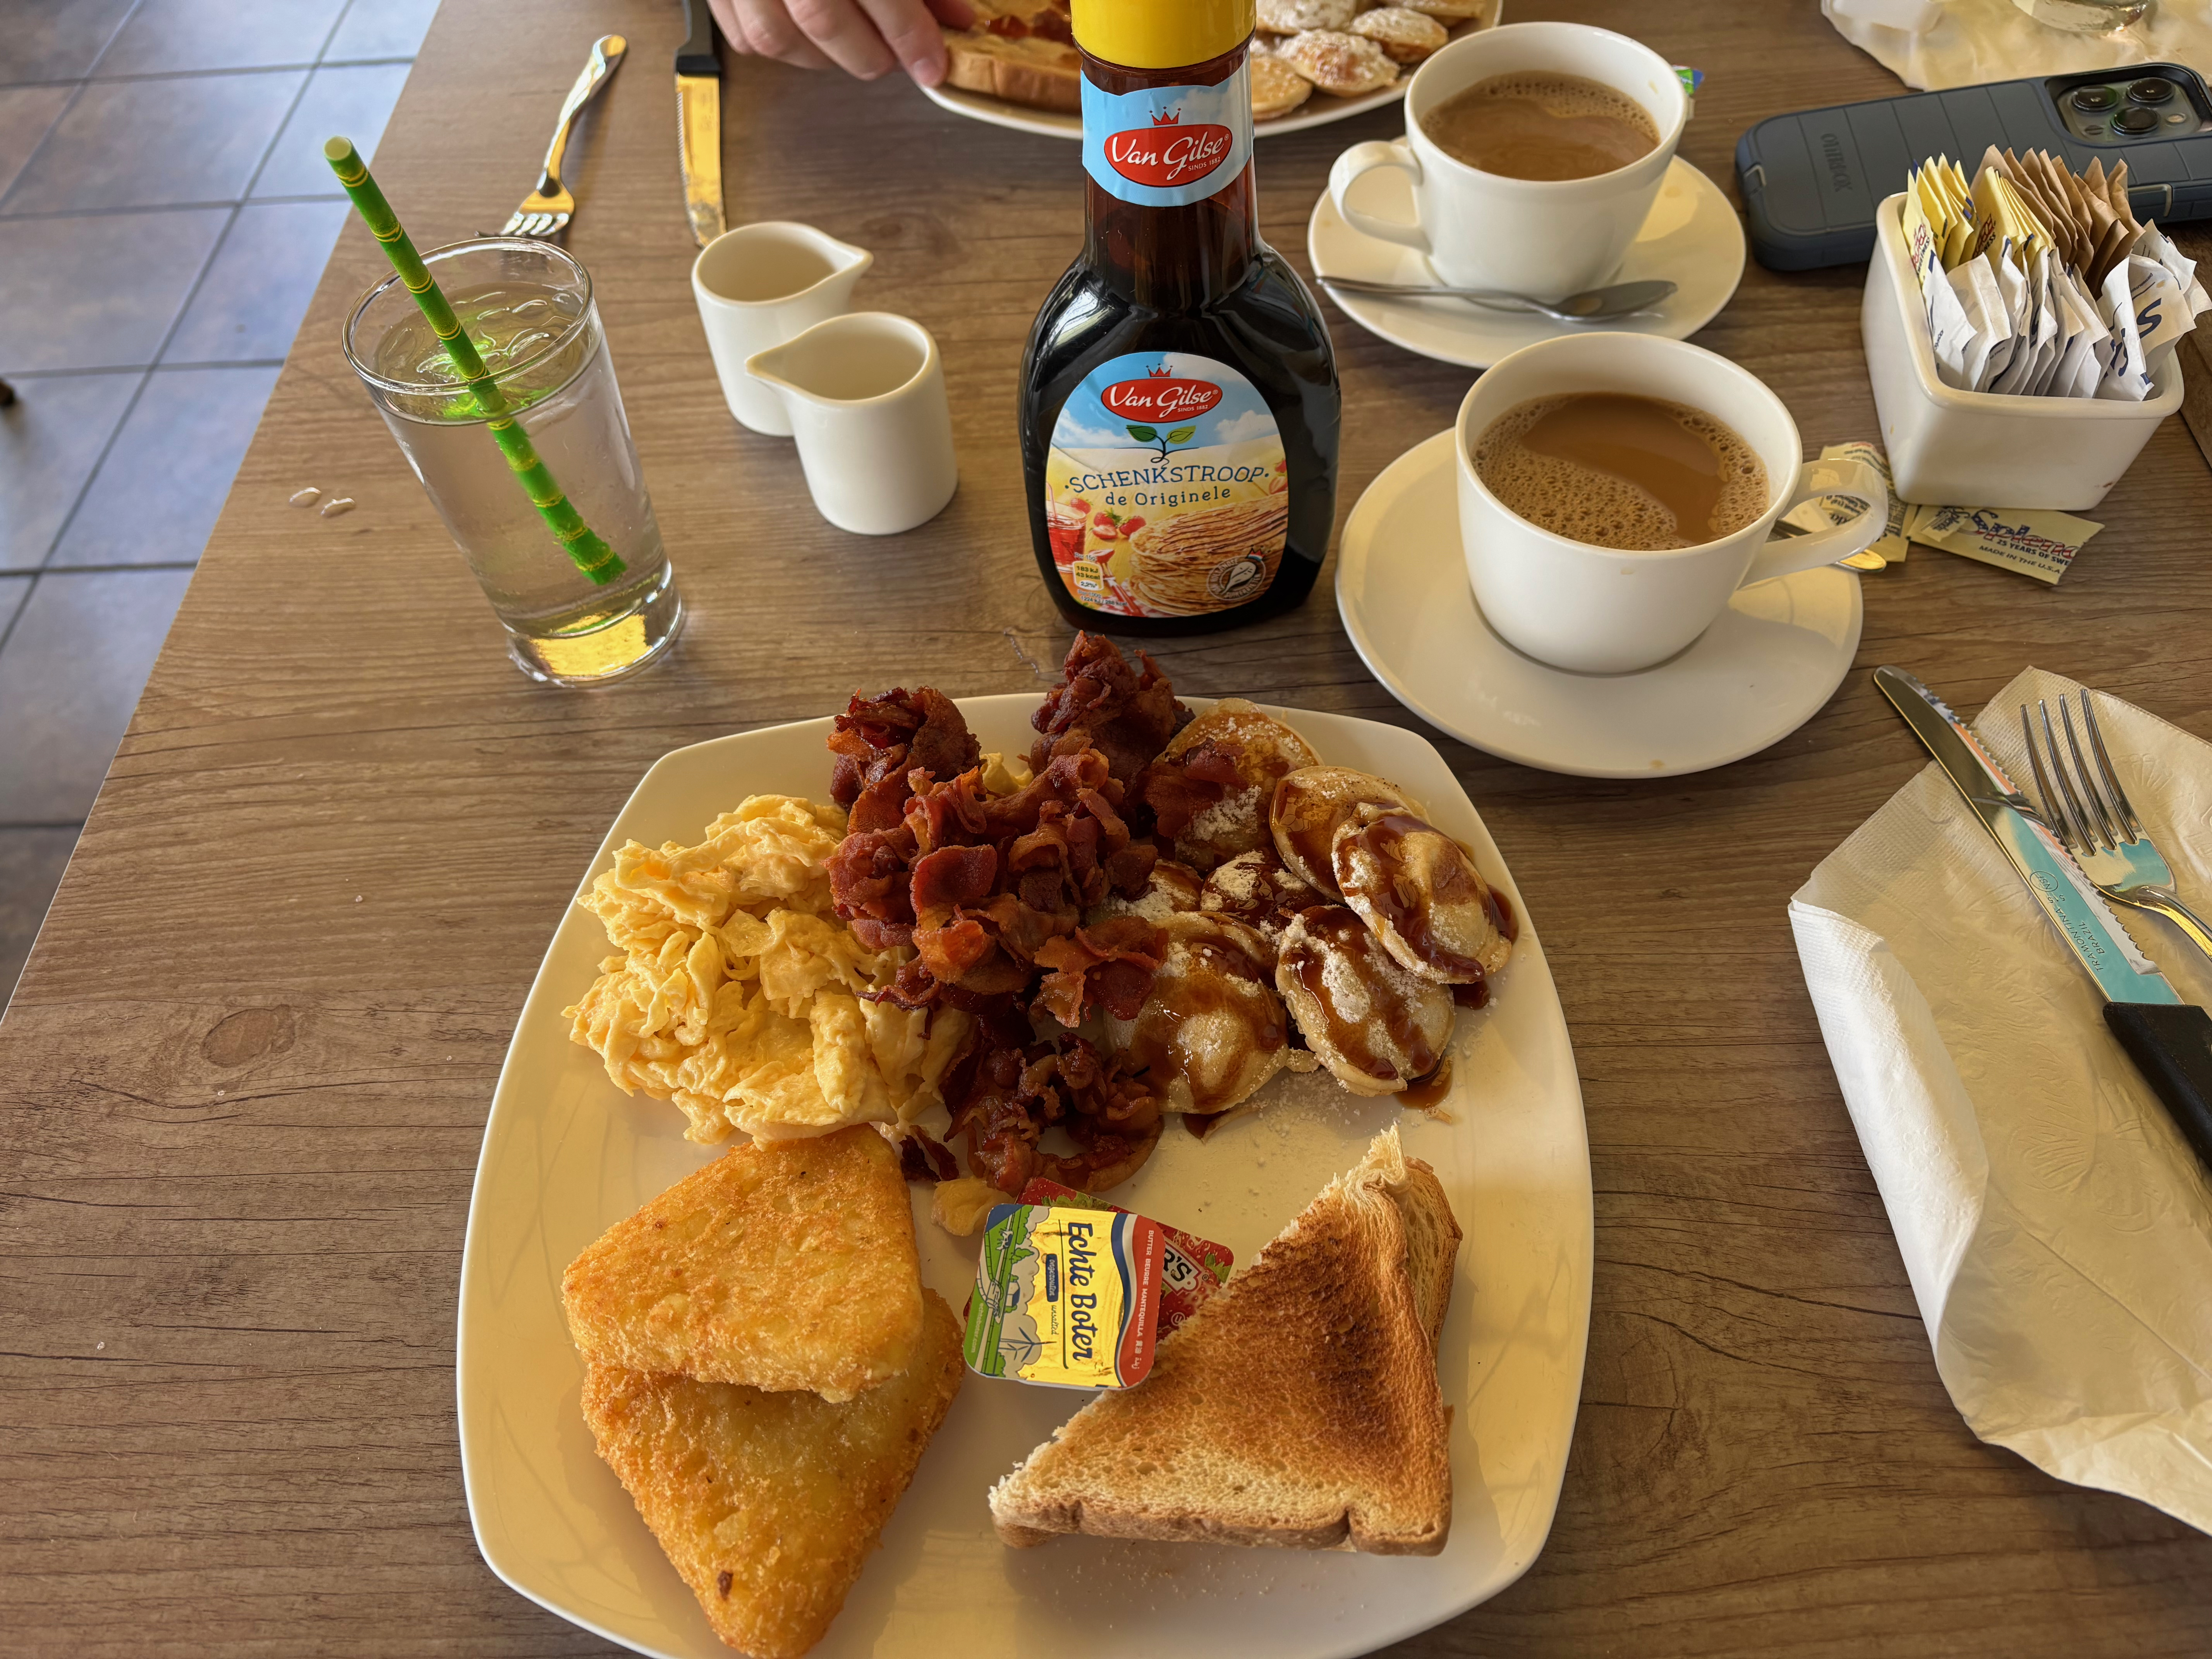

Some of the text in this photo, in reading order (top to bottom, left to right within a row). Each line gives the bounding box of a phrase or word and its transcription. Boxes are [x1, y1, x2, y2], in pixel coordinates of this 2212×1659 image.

[1112, 131, 1224, 180] Van Gilse
[1188, 156, 1221, 171] SINDS 1882
[1110, 385, 1212, 418] Van Gilse
[1106, 486, 1231, 507] de Originele
[1979, 545, 2005, 558] MADE
[2006, 552, 2017, 560] IN
[2019, 556, 2037, 566] THE
[2009, 542, 2037, 556] YEARS
[2039, 551, 2049, 560] OF
[2056, 908, 2104, 972] TRAMONTINA
[2078, 921, 2105, 954] BRAZIL
[1068, 1222, 1097, 1361] Echte Boter
[1137, 1230, 1154, 1337] BUTTER BEURRE MANTEQUILLA
[1051, 1305, 1060, 1336] unsalted
